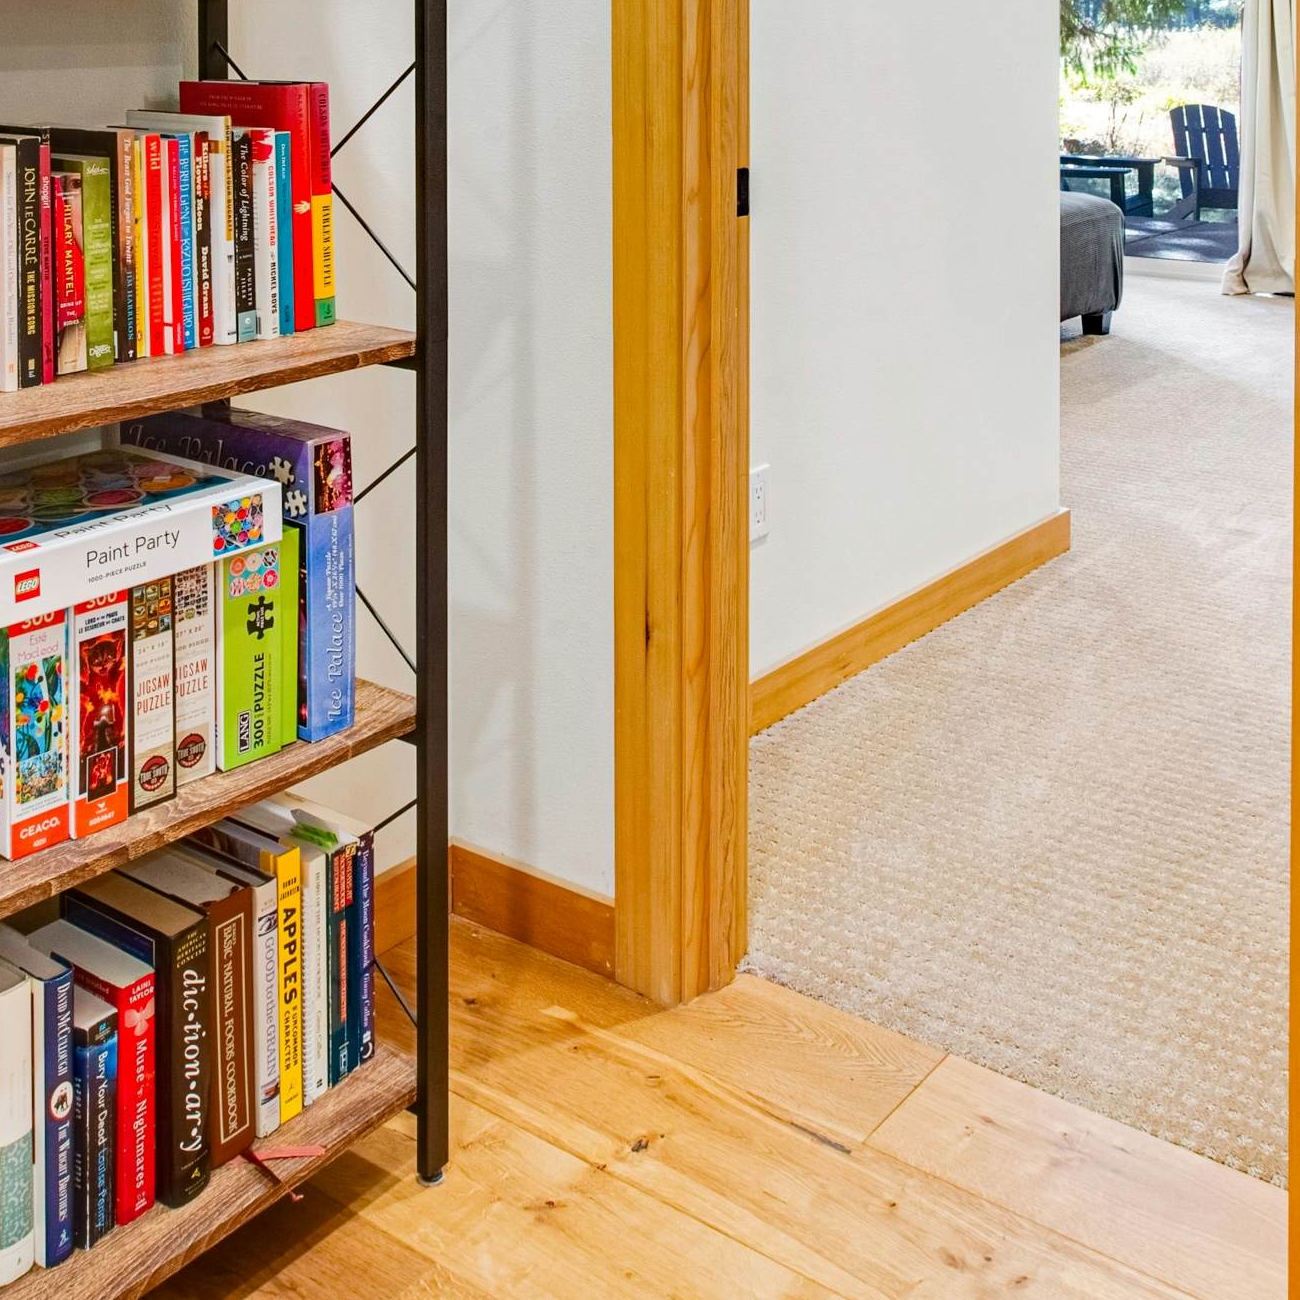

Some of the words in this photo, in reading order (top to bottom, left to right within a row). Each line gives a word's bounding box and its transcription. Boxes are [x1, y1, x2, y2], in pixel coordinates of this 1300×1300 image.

[240, 143, 249, 160] The
[24, 167, 36, 202] JOHN
[41, 175, 51, 209] shopgirl
[196, 156, 204, 197] Flower
[240, 162, 249, 191] Color
[267, 165, 275, 197] COLSON
[63, 204, 73, 246] HILARY
[196, 198, 204, 231] Moon
[239, 199, 251, 241] Lightning
[322, 205, 331, 243] HARLEM
[24, 218, 38, 265] CARRÉ
[181, 238, 192, 276] KAZUO
[27, 270, 36, 283] THE
[64, 249, 74, 297] MANTEL
[201, 246, 209, 281] David
[322, 245, 331, 287] SHUFFLE
[27, 284, 36, 315] MISSION
[182, 280, 194, 329] ISHIGURO
[202, 281, 211, 318] Grann
[27, 315, 36, 336] SONG
[86, 544, 133, 568] Paint
[135, 529, 180, 554] Party
[17, 577, 39, 592] LEGO
[88, 568, 123, 584] 1000-PIECE
[124, 561, 147, 573] PUZZLE
[326, 612, 344, 682] Palace
[137, 673, 170, 697] JIGSAW
[253, 653, 264, 712] PUZZLE
[137, 691, 171, 716] PUZZLE
[328, 690, 342, 722] Ice
[239, 711, 250, 751] LANG
[253, 720, 264, 749] 300
[361, 849, 370, 882] Beyond
[361, 883, 370, 898] the
[362, 900, 370, 924] Moon
[223, 927, 233, 960] BASIC
[264, 936, 276, 983] GOOD
[282, 907, 298, 1005] APPLES
[361, 924, 370, 970] Cookbook
[129, 986, 155, 1004] TAYLOR
[223, 963, 234, 1017] NATURAL
[266, 983, 275, 999] to
[266, 999, 276, 1025] the
[225, 1018, 236, 1060] FOODS
[266, 1024, 277, 1077] GRAIN
[283, 1010, 291, 1071] CHARACTER
[96, 1050, 108, 1080] Bury
[135, 1038, 148, 1083] Muse
[97, 1080, 108, 1108] Your
[226, 1061, 238, 1131] COOKBOOK
[97, 1110, 108, 1146] Dead
[133, 1098, 148, 1189] Nightmares
